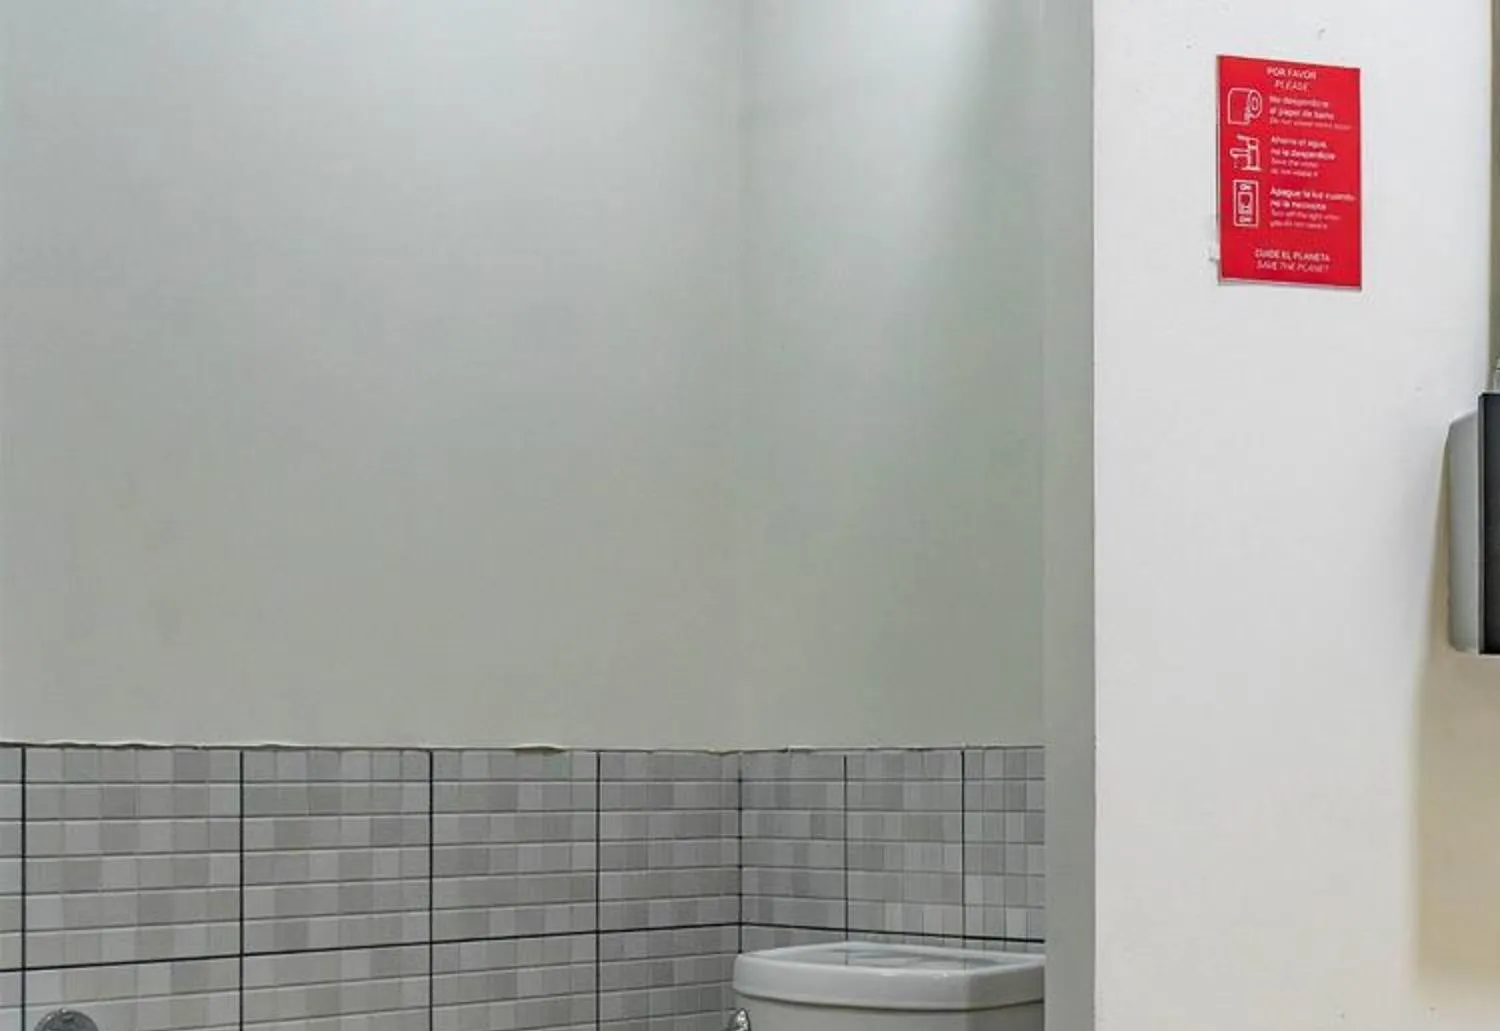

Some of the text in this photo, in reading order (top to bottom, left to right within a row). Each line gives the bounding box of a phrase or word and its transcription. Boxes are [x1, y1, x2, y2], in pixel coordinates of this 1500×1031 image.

[1266, 66, 1317, 80] POR FAVOR
[1274, 79, 1310, 91] PLEASE
[1255, 247, 1331, 263] CUIDE EL PLANETA
[1256, 259, 1330, 273] SAVE THE PLANET
